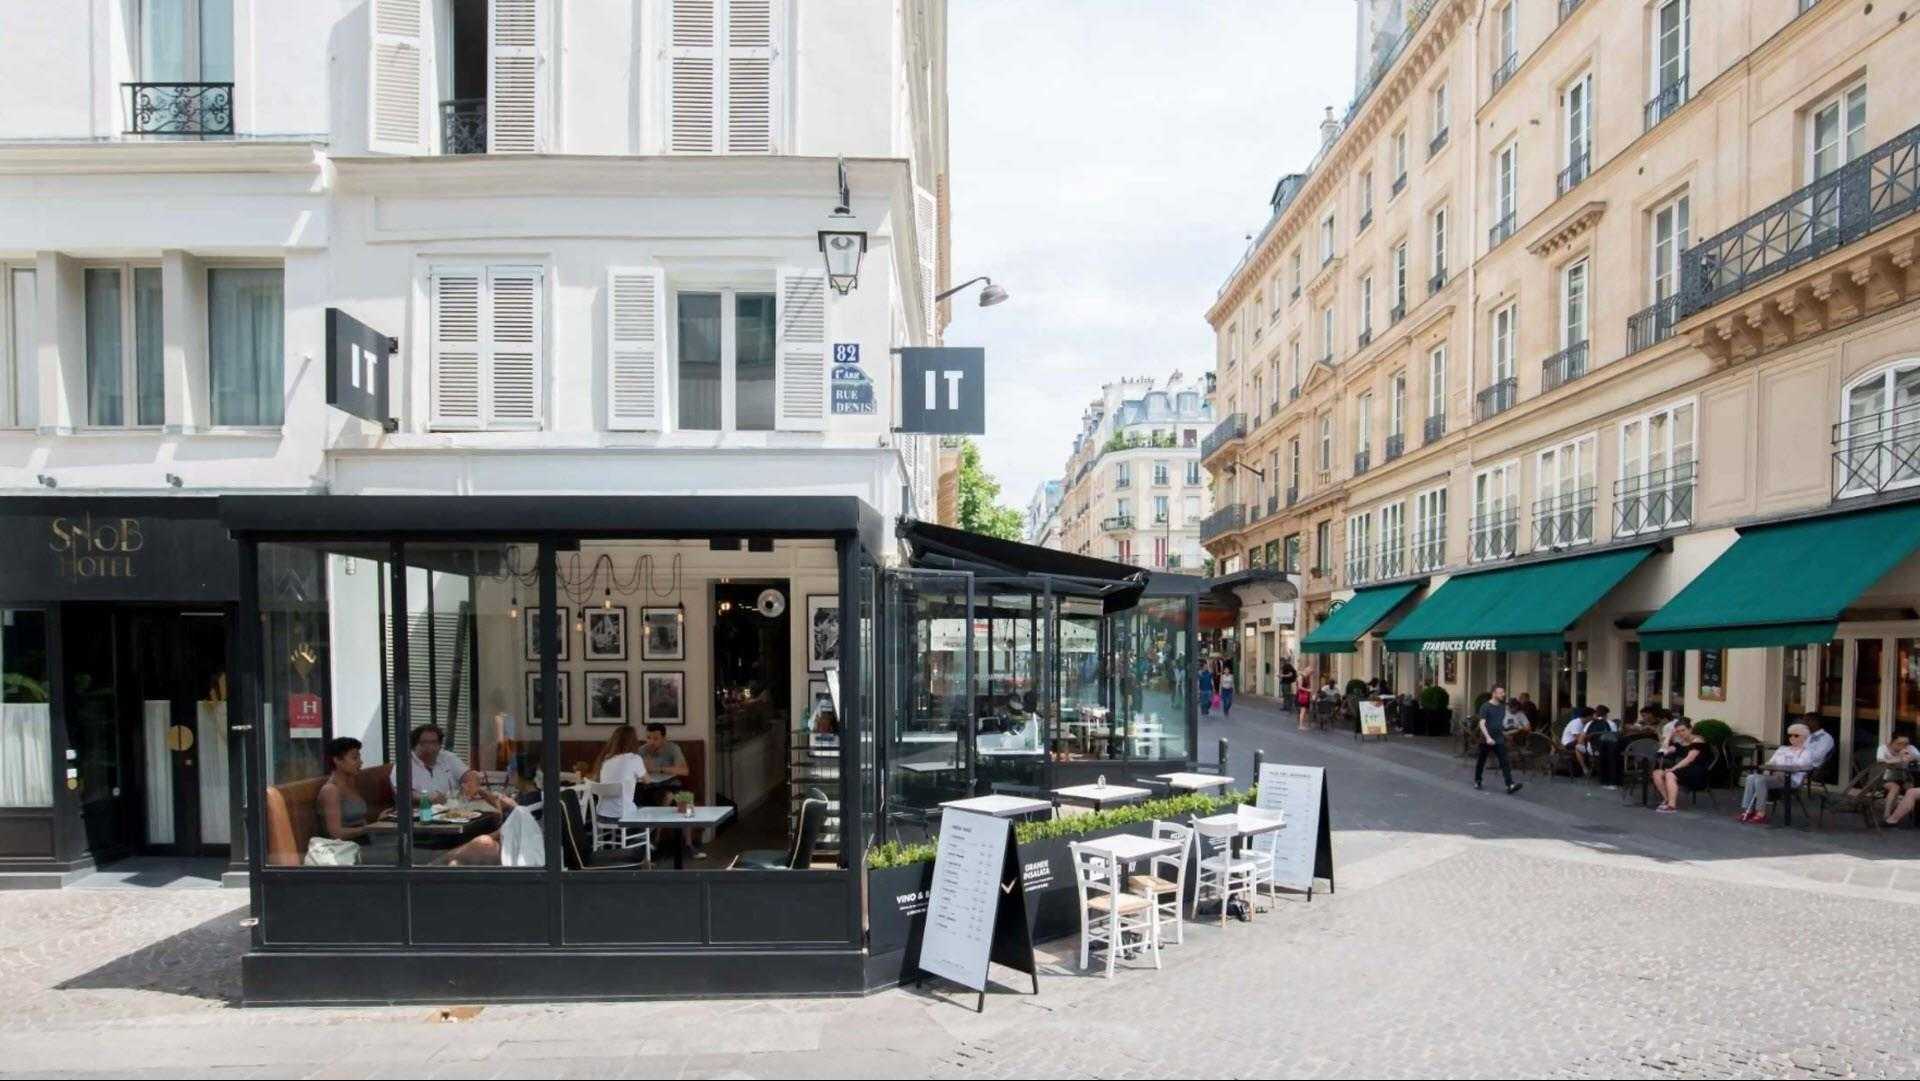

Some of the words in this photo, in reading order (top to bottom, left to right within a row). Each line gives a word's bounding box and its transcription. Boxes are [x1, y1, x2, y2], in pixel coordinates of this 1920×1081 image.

[836, 344, 857, 362] 82
[351, 343, 378, 396] IT
[835, 389, 859, 400] RUE
[925, 370, 964, 410] IT
[1422, 640, 1464, 652] STARBUCKS
[1465, 639, 1497, 651] COFFEE
[303, 700, 318, 714] H
[896, 892, 917, 904] VINO
